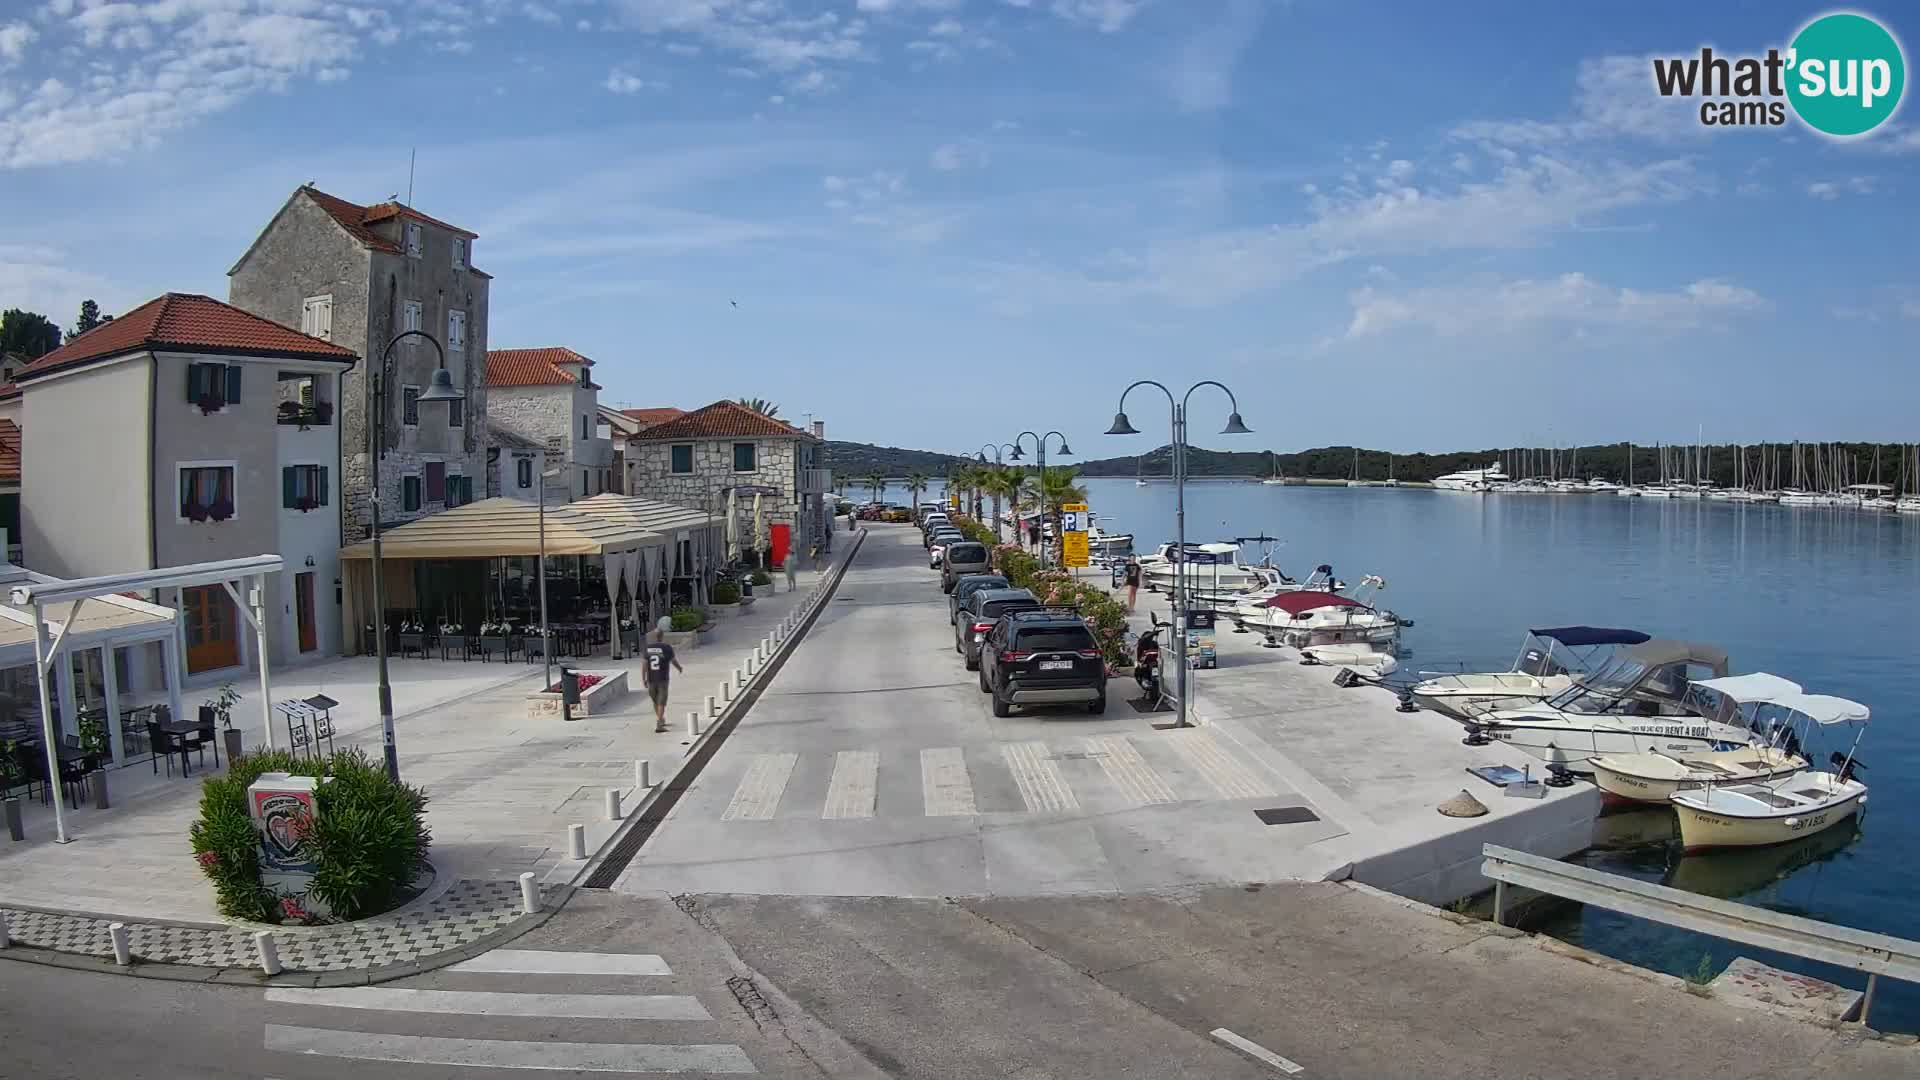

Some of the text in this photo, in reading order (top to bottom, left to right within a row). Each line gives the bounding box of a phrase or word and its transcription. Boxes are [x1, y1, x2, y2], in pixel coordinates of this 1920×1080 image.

[1065, 513, 1076, 529] P
[650, 655, 660, 670] 2
[1666, 726, 1684, 735] RENT
[1691, 727, 1709, 737] BOAT
